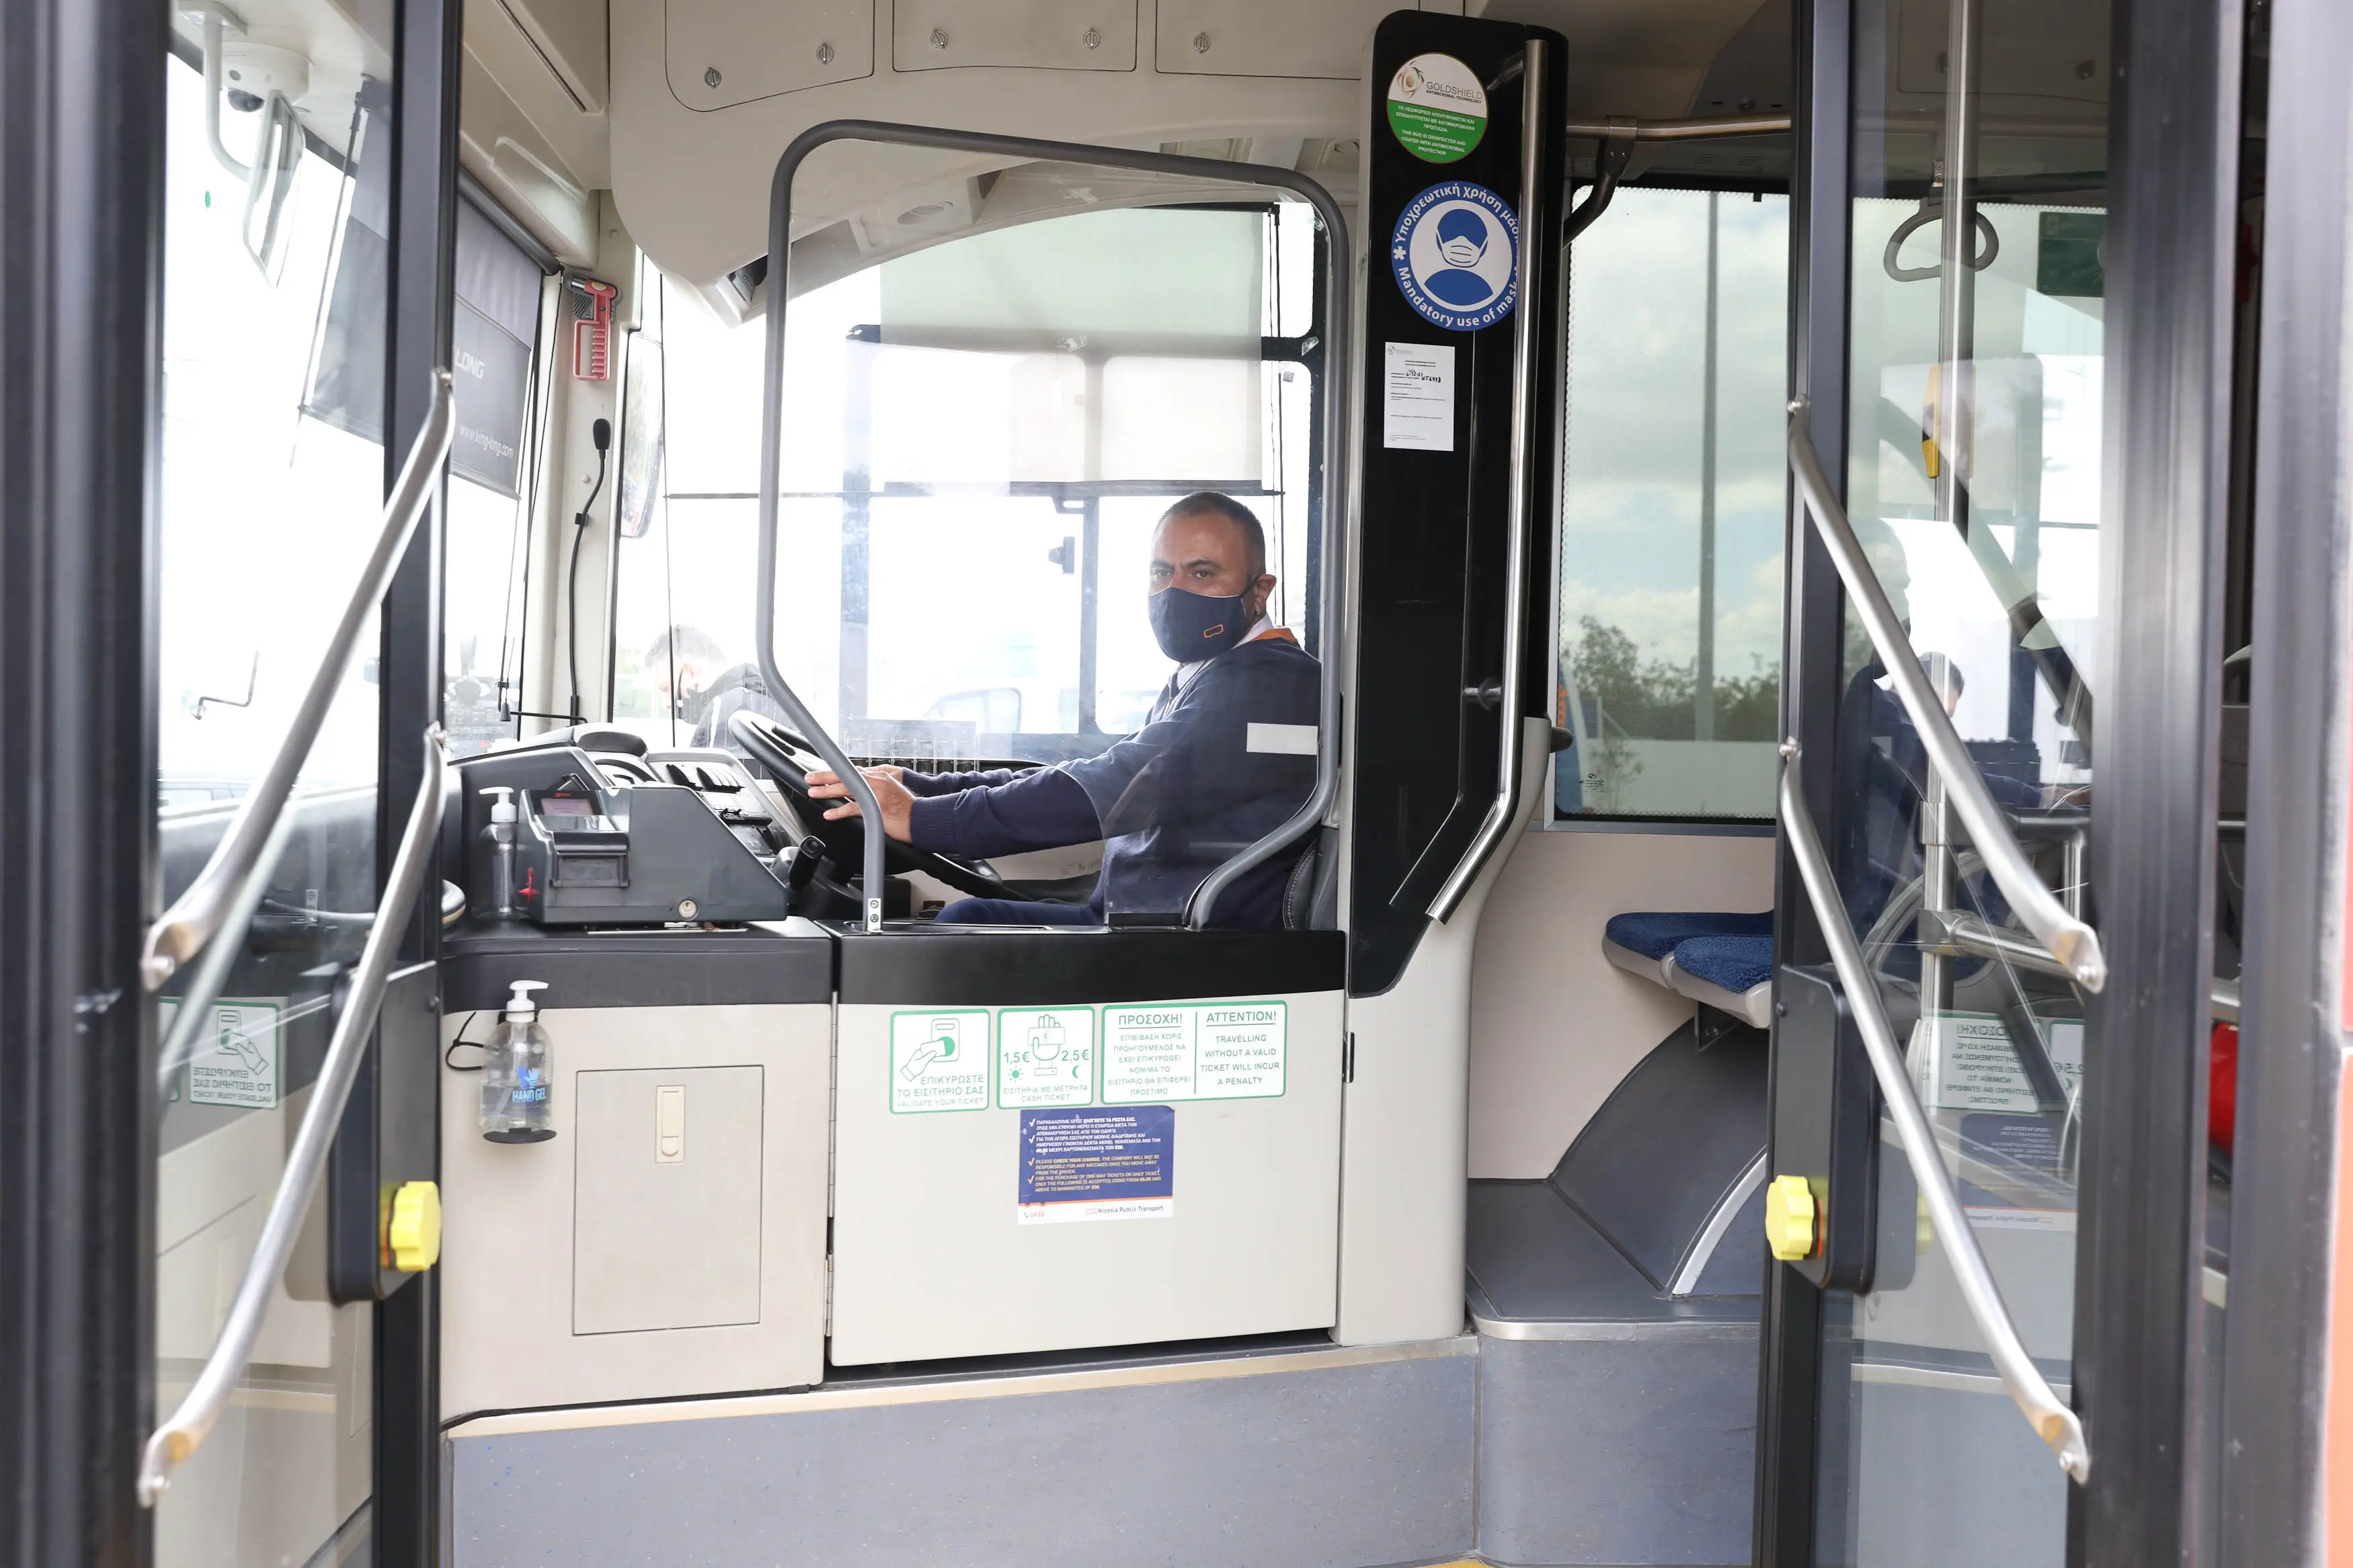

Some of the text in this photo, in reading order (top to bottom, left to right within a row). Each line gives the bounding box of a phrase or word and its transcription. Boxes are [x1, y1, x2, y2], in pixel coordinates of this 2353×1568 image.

[1427, 81, 1483, 99] GOLDSHIELD
[1426, 89, 1482, 104] ANTIMICROBIAL TECHNOLOGY
[1428, 134, 1456, 144] DISINFECTED
[1419, 147, 1446, 155] PROTECTION
[1431, 141, 1466, 152] ANTIMICROBIAL
[1395, 183, 1460, 243] Υποχρεωτική
[1463, 186, 1502, 212] χρήση
[1398, 267, 1453, 327] Mandatory
[1457, 317, 1479, 327] use
[1482, 308, 1496, 323] of
[454, 347, 485, 380] LONG
[460, 423, 514, 460] www.king-long.com
[1119, 1014, 1183, 1026] ΠΡΟΣΟΧΗ!
[1206, 1011, 1277, 1022] ATTENTION!
[1120, 1034, 1159, 1042] ΕΠΙΒΙΒΑΣΗ
[1215, 1034, 1267, 1043] TRAVELLING
[1113, 1044, 1174, 1053] ΠΡΟΗΓΟΥΜΕΝΩΣ
[1205, 1049, 1243, 1057] WITHOUT
[1137, 1055, 1181, 1063] ΕΠΙΚΥΡΩΘΕΙ
[1129, 1066, 1158, 1074] ΝΟΜΙΜΑ
[1201, 1064, 1230, 1072] TICKET
[921, 1075, 984, 1085] ΕΠΙΚΥΡΩΣΤΕ
[1226, 1077, 1263, 1085] PENALTY
[512, 1087, 546, 1102] HAND GEL
[898, 1086, 984, 1098] ΤΟ ΕΙΣΙΤΗΡΙΟ ΣΑΣ
[1004, 1087, 1038, 1095] ΕΙΣΙΤΗΡΙΑ
[936, 1098, 956, 1106] YOUR
[1022, 1094, 1042, 1102] CASH
